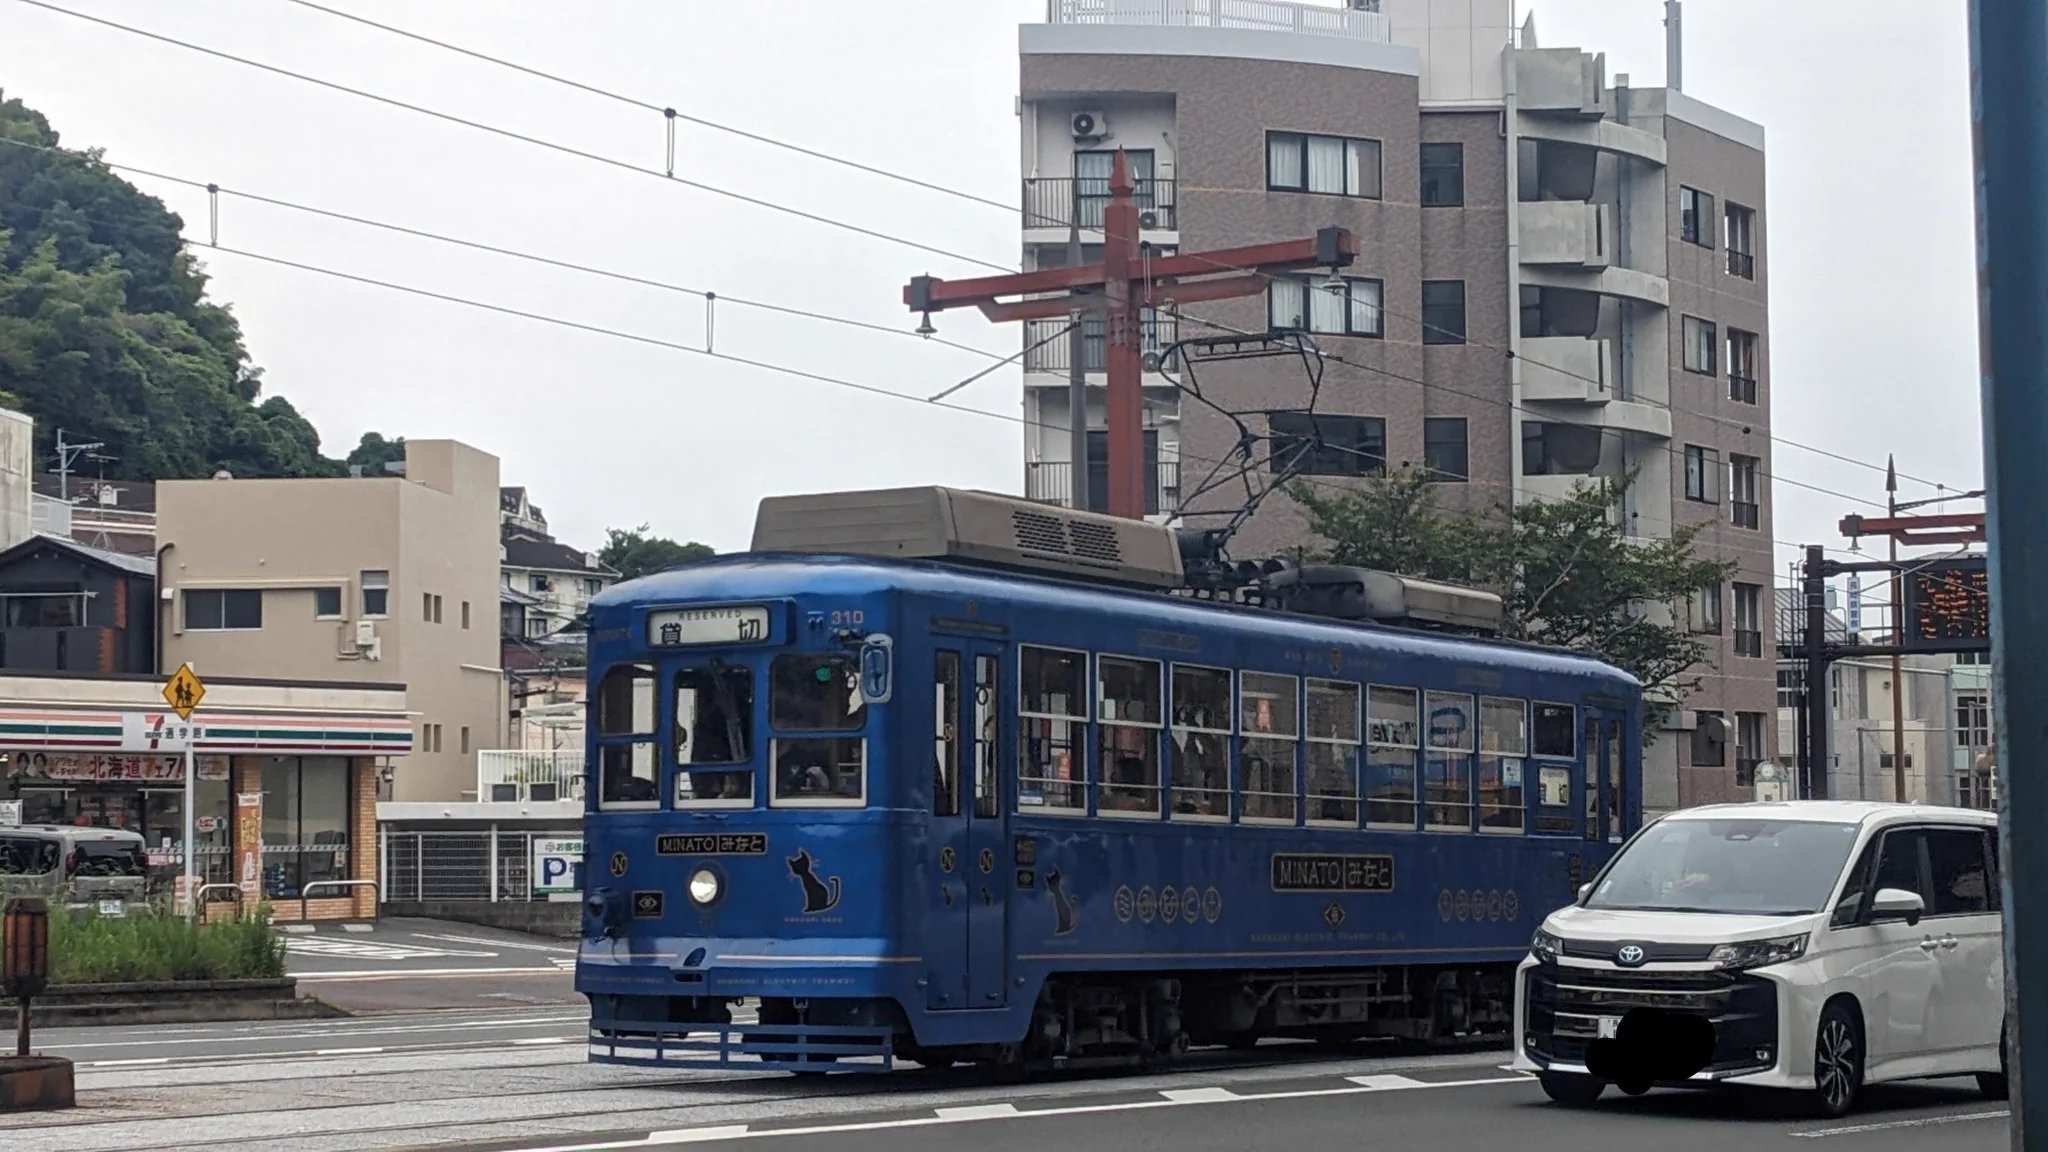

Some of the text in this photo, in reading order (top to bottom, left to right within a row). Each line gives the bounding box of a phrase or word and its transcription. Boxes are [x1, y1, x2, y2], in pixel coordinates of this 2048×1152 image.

[679, 609, 742, 621] RESERVED
[831, 610, 863, 625] 310
[662, 837, 763, 852] MINATO みなと
[543, 857, 567, 885] P
[1280, 860, 1390, 887] MINATO みなと
